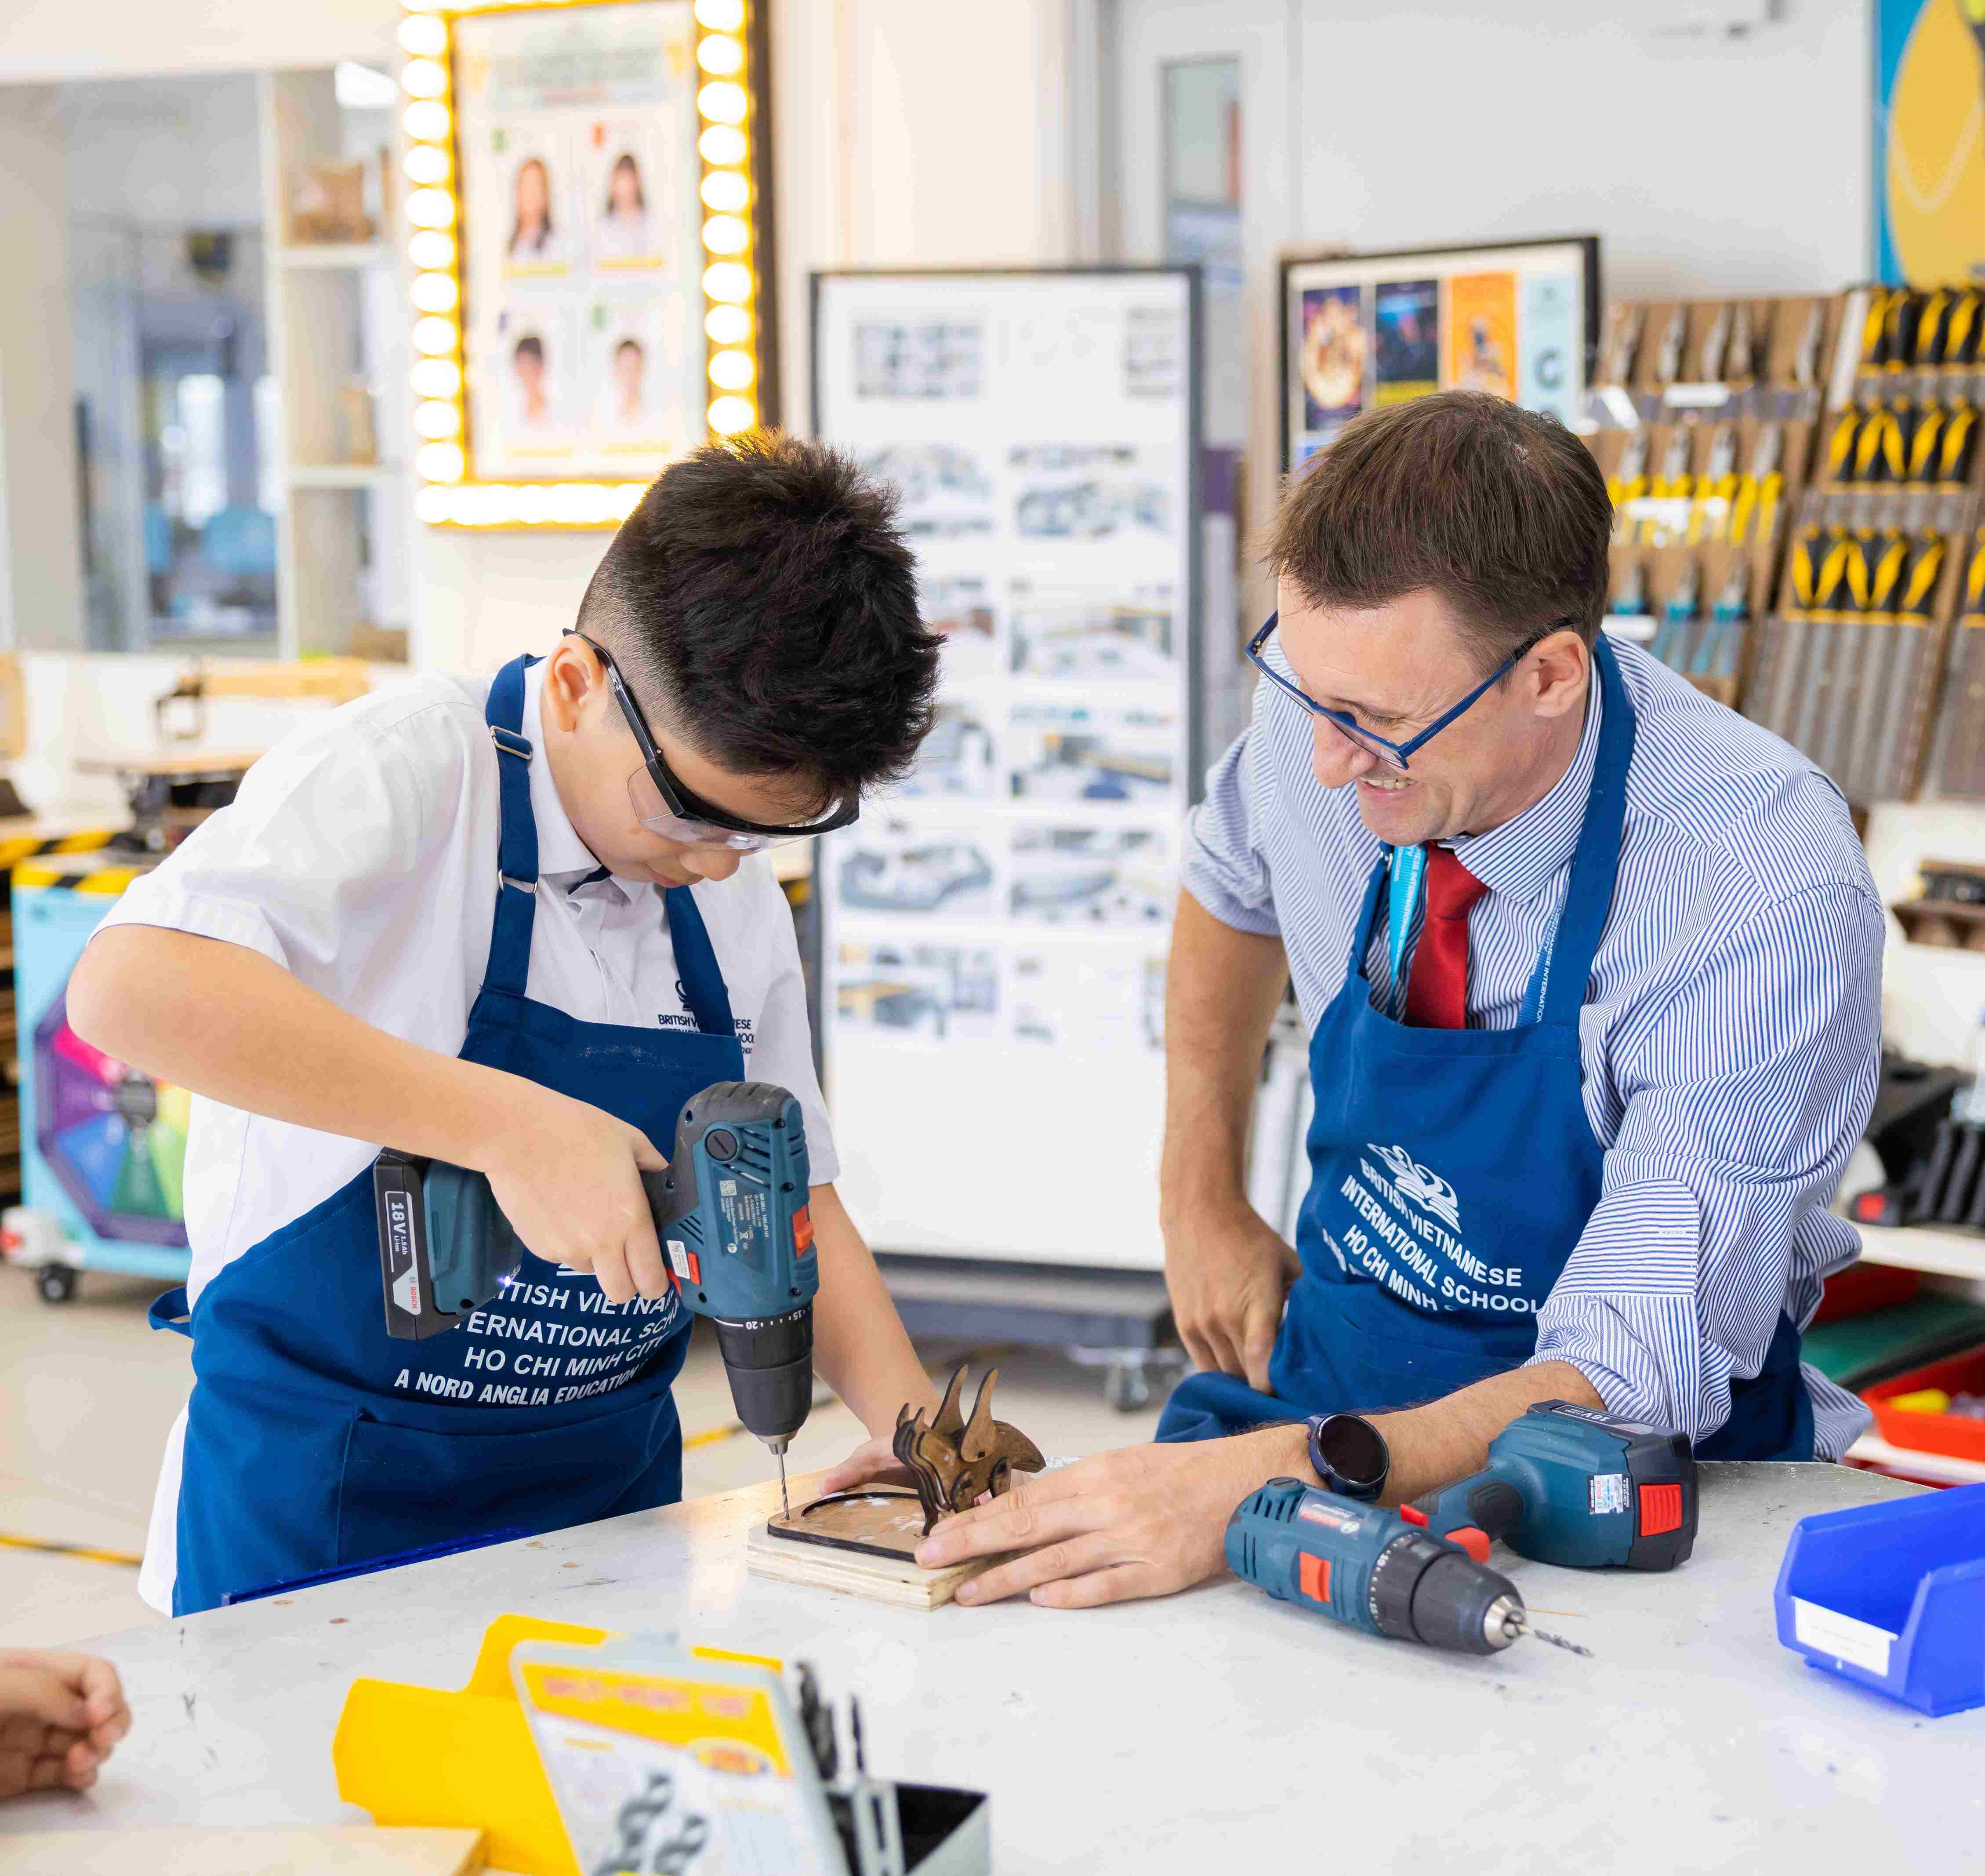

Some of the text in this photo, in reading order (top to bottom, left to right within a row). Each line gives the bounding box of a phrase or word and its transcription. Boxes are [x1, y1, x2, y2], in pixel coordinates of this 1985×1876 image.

[658, 1014, 690, 1026] BRITISH
[391, 1202, 406, 1234] 18V
[1359, 1157, 1408, 1219] BRITISH
[1408, 1209, 1522, 1287] VIETNAMESE
[1341, 1174, 1438, 1288] INTERNATIONAL
[1441, 1276, 1541, 1313] SCHOOL
[1343, 1224, 1368, 1255] HO
[1363, 1247, 1390, 1281] CHI
[1388, 1269, 1438, 1311] MINH
[494, 1281, 570, 1309] ITISH
[454, 1311, 632, 1347] ERNATIONAL
[746, 1321, 758, 1330] 20
[793, 1309, 802, 1321] 15
[464, 1346, 506, 1371] HO
[514, 1354, 561, 1376] CHI
[565, 1351, 624, 1376] MINH
[626, 1331, 670, 1361] CITY
[394, 1369, 409, 1388] A
[415, 1372, 474, 1399] NORD
[478, 1384, 549, 1405] ANGLIA
[554, 1364, 639, 1404] EDUCATION
[1581, 1412, 1611, 1422] 18V
